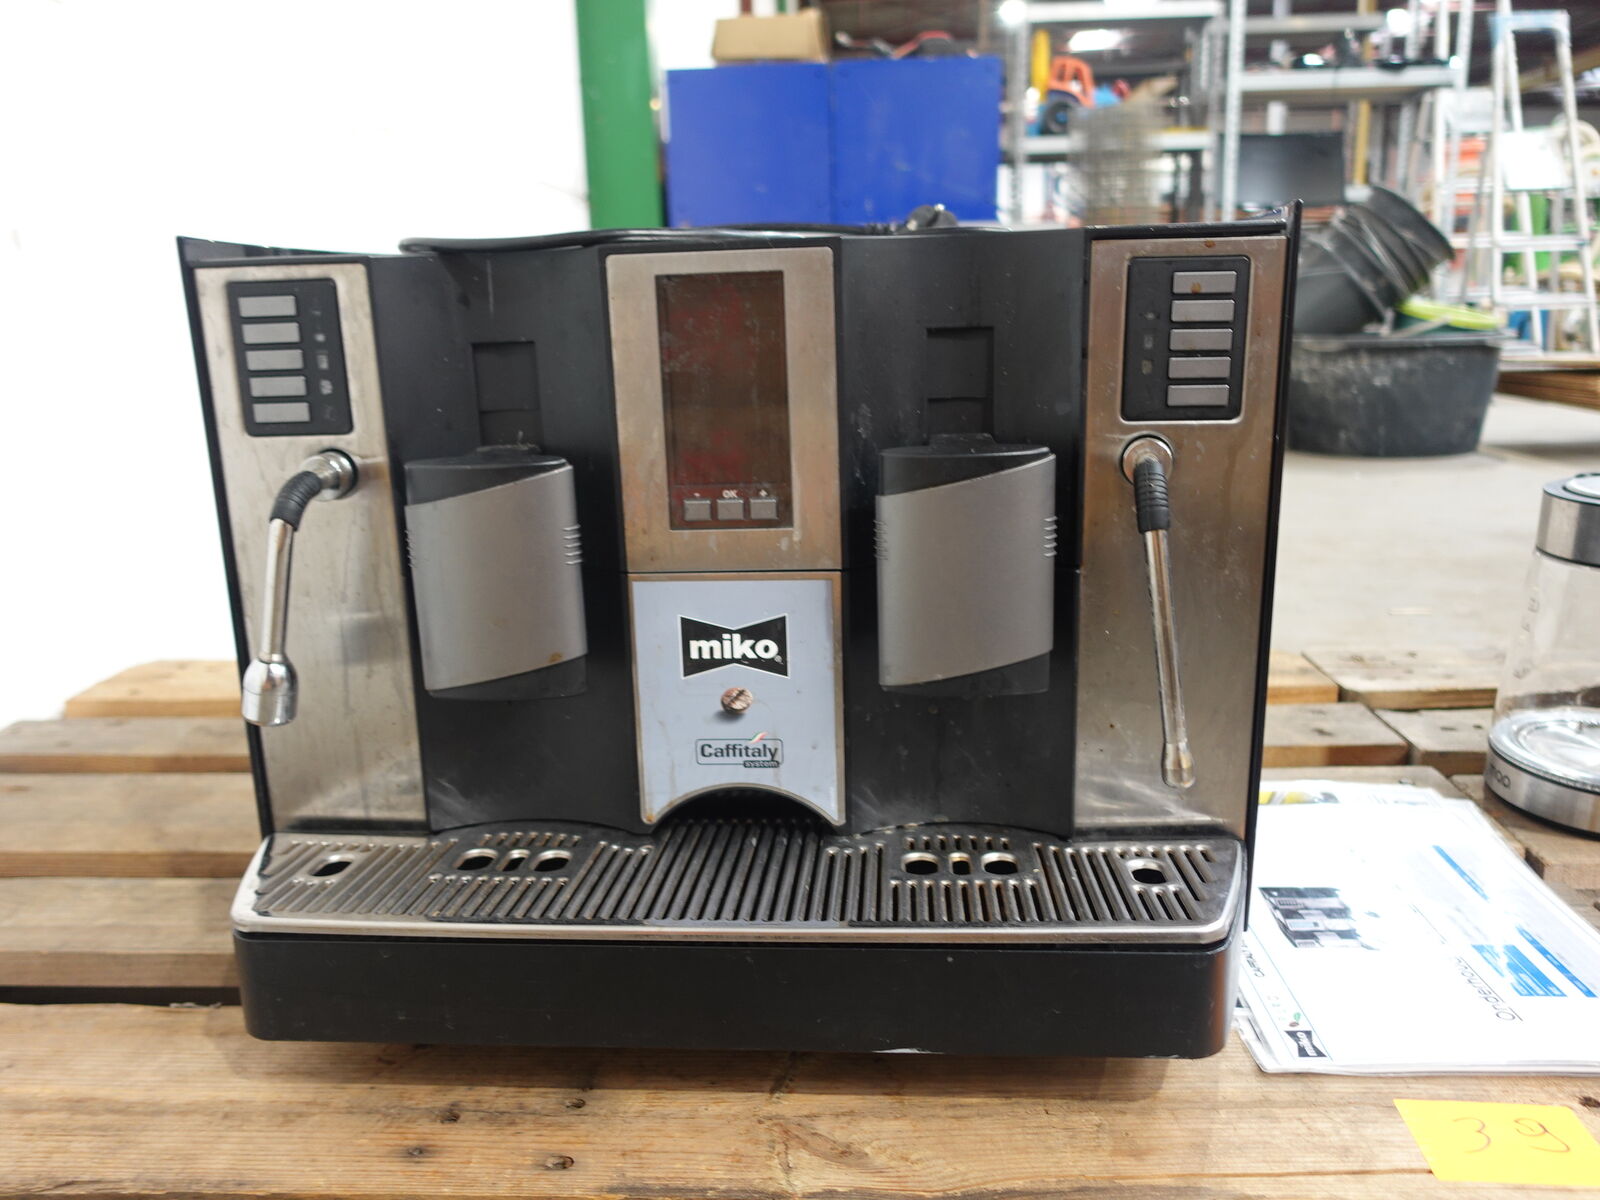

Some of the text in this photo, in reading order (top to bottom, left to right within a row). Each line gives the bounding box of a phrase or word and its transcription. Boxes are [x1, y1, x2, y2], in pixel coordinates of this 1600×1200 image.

[722, 489, 738, 498] OK
[689, 633, 779, 660] miko
[700, 743, 779, 760] Caffitaly
[744, 760, 778, 768] system
[1453, 1117, 1571, 1153] 39
